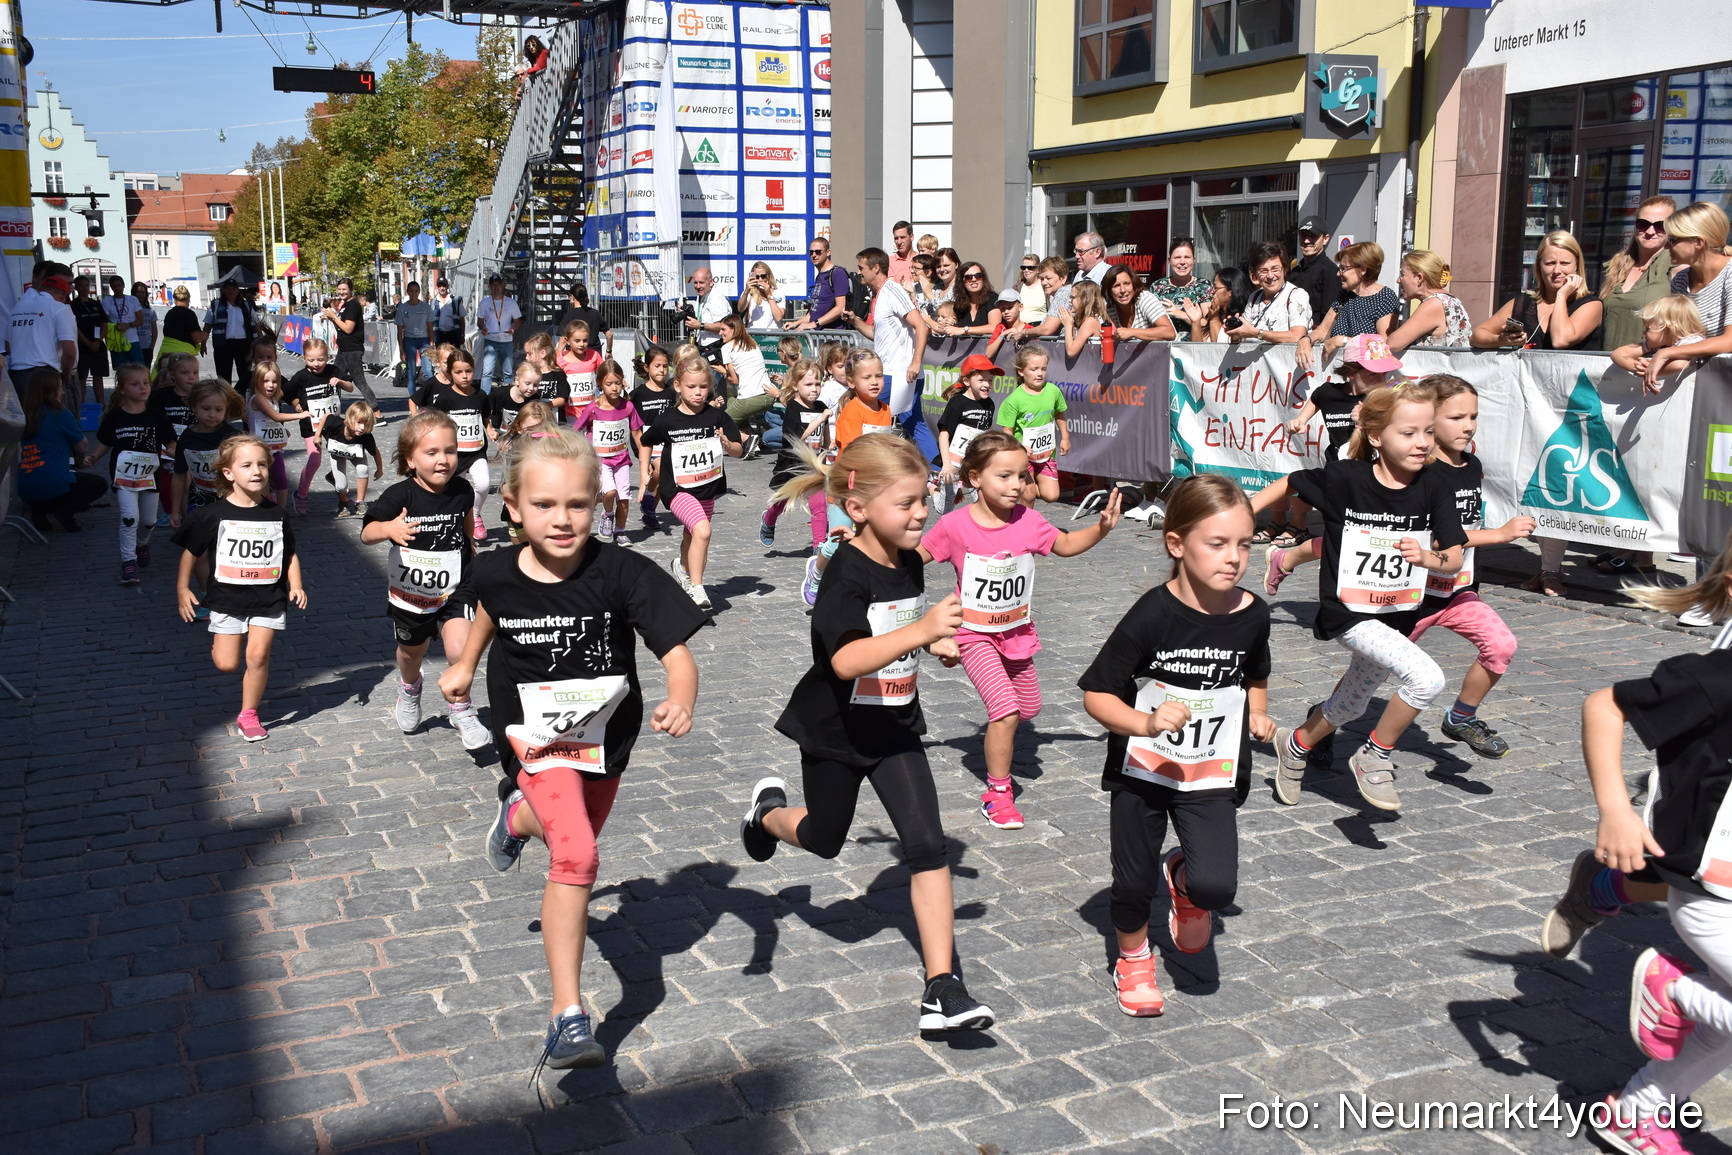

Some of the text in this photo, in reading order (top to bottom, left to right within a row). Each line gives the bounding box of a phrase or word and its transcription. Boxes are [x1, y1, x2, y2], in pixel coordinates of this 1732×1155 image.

[705, 16, 725, 26] CODE
[706, 23, 728, 33] CLINIC
[1494, 19, 1587, 52] Unterer Markt 15
[758, 60, 788, 74] Burgis
[361, 74, 373, 91] 4
[1339, 77, 1362, 111] G2
[691, 106, 734, 115] VARIOTEC
[775, 117, 802, 125] energie
[747, 146, 788, 159] charivari
[766, 196, 783, 206] Braun
[682, 230, 716, 242] swn
[755, 244, 796, 252] Lammsbräu
[1118, 244, 1138, 254] HAPPY
[572, 381, 594, 393] 7351
[1251, 369, 1315, 410] UNS
[1089, 384, 1147, 407] LOUNGE
[315, 403, 338, 418] 7116
[261, 427, 284, 440] 7099
[599, 428, 625, 442] 7452
[667, 427, 703, 436] Neumarkter
[1029, 433, 1053, 449] 7082
[680, 450, 715, 469] 7441
[124, 462, 155, 476] 7110
[694, 474, 707, 482] Lisa
[404, 514, 452, 524] Neumarkter
[1345, 508, 1406, 524] Neumarkter
[236, 526, 267, 535] BOCK
[1538, 514, 1577, 532] Gebäude
[1578, 520, 1611, 536] Service
[1613, 525, 1648, 541] GmbH
[227, 537, 274, 559] 7050
[409, 554, 442, 566] BOCK
[240, 569, 259, 579] Lara
[987, 562, 1018, 575] BOCK
[398, 564, 450, 590] 7030
[974, 575, 1026, 602] 7500
[1358, 579, 1403, 589] PARTL Neumarkt
[1369, 592, 1396, 604] Luise
[977, 602, 1016, 610] PARTL Neumarkt
[499, 614, 577, 629] Neumarkter
[988, 613, 1010, 625] Julia
[1156, 646, 1234, 662] Neumarkter
[553, 688, 607, 703] BOCK
[1153, 743, 1207, 765] PARTL Neumarkt
[1719, 828, 1731, 838] B1
